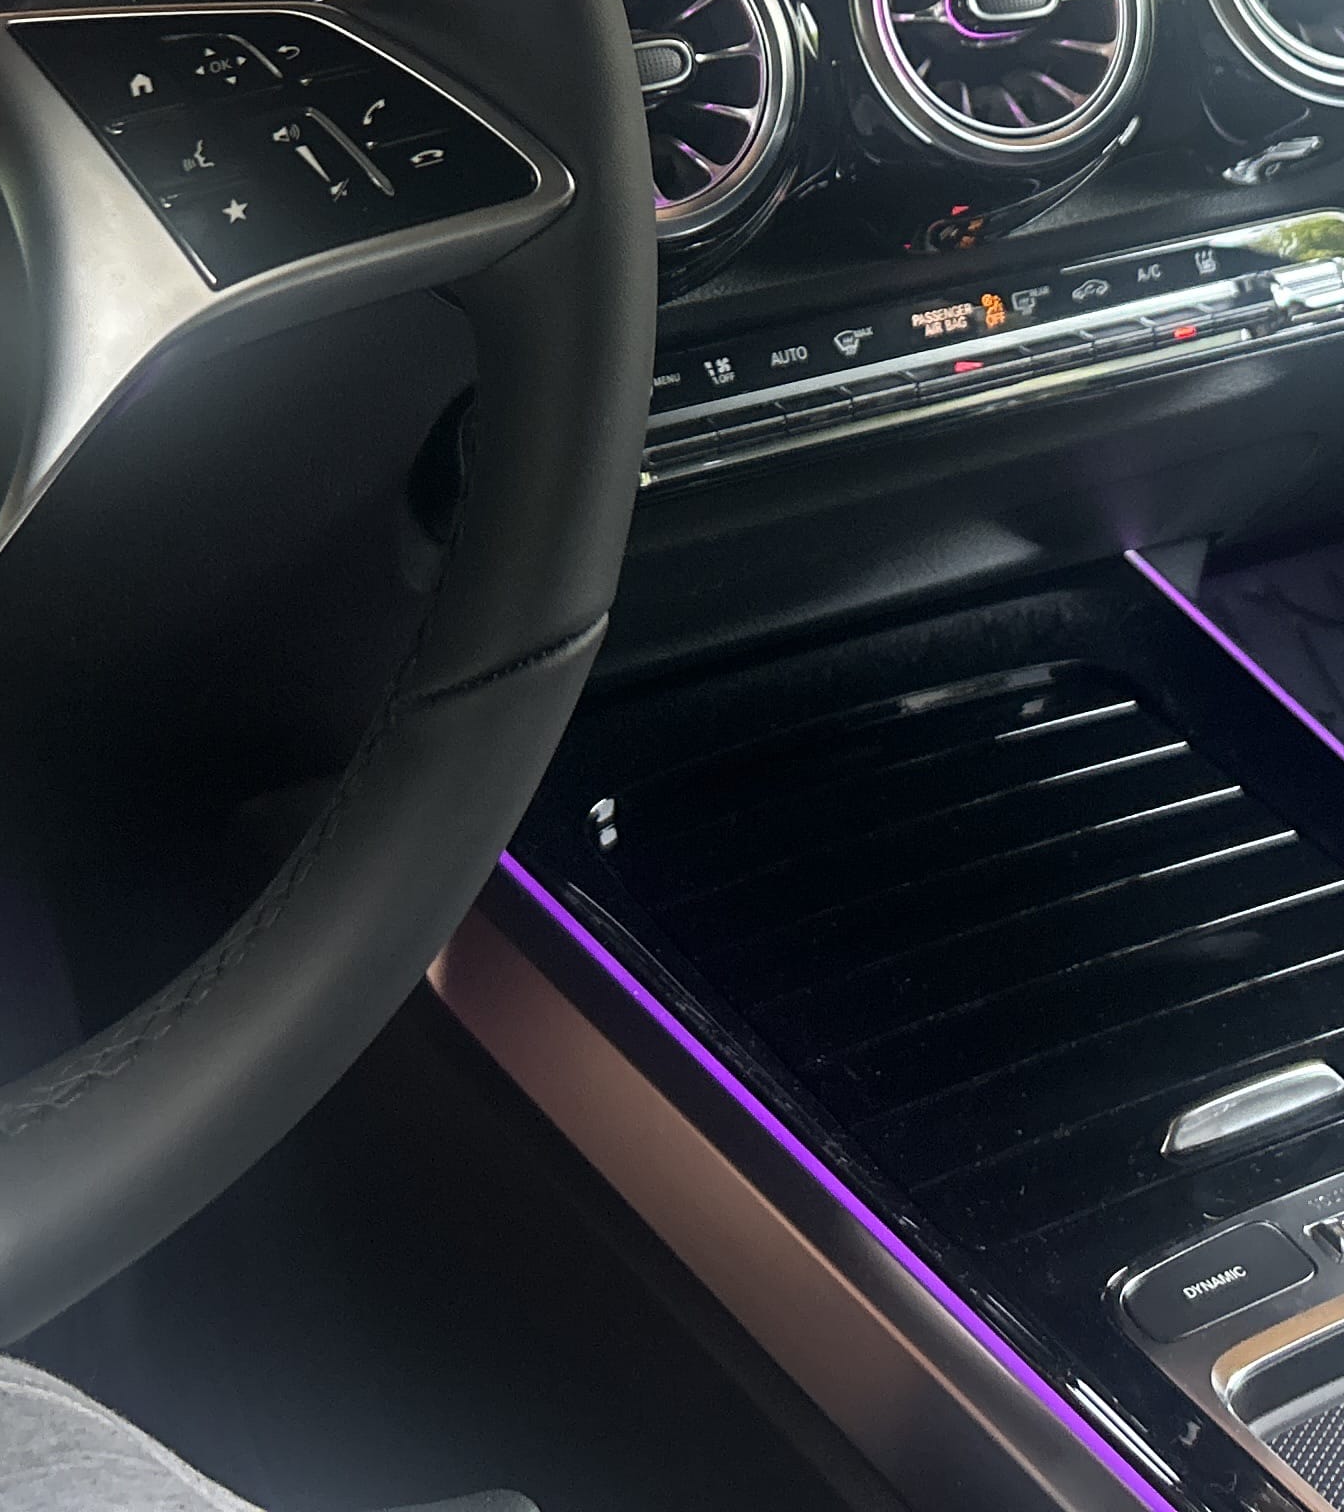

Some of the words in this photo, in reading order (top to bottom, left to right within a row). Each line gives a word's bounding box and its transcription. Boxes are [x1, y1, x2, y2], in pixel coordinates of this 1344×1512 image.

[209, 58, 233, 74] OK
[770, 345, 809, 368] AUTO
[1182, 1265, 1247, 1299] DYNAMIC
